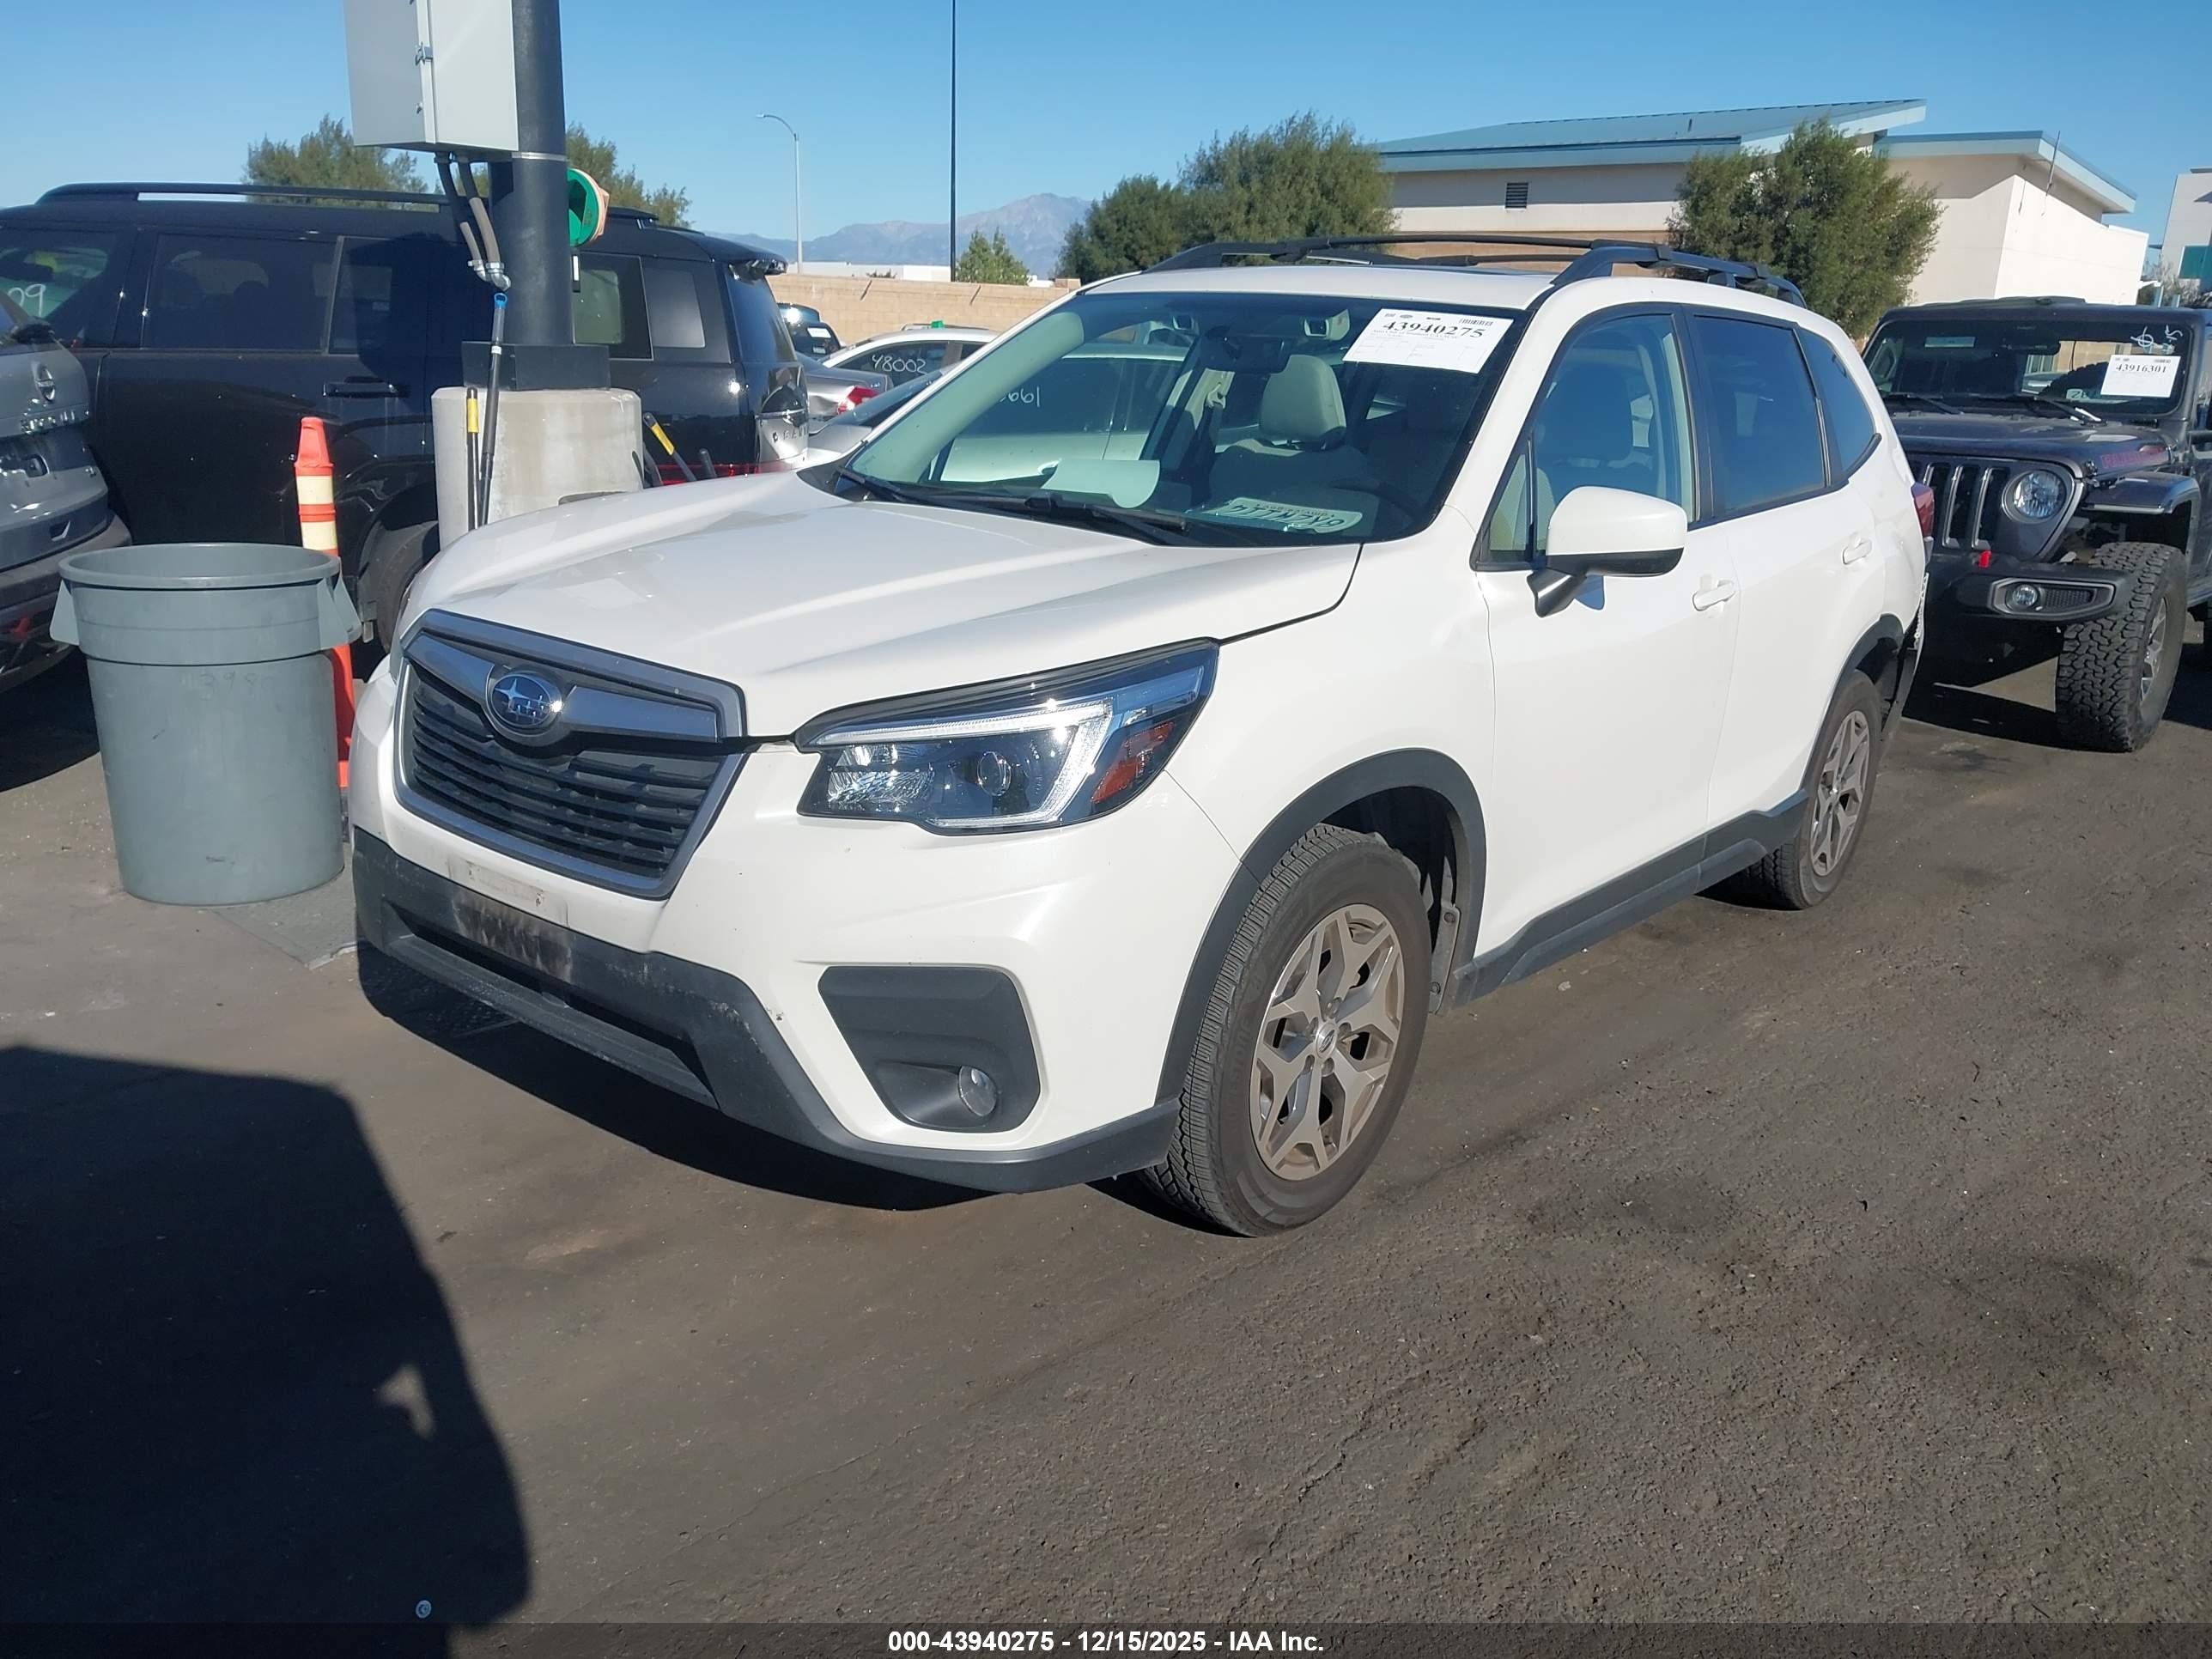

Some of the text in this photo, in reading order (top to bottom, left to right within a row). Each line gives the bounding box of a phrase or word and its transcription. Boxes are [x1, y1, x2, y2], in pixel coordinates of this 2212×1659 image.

[1383, 320, 1486, 338] 43940275
[872, 354, 928, 375] 48002
[2115, 363, 2167, 374] 43916301
